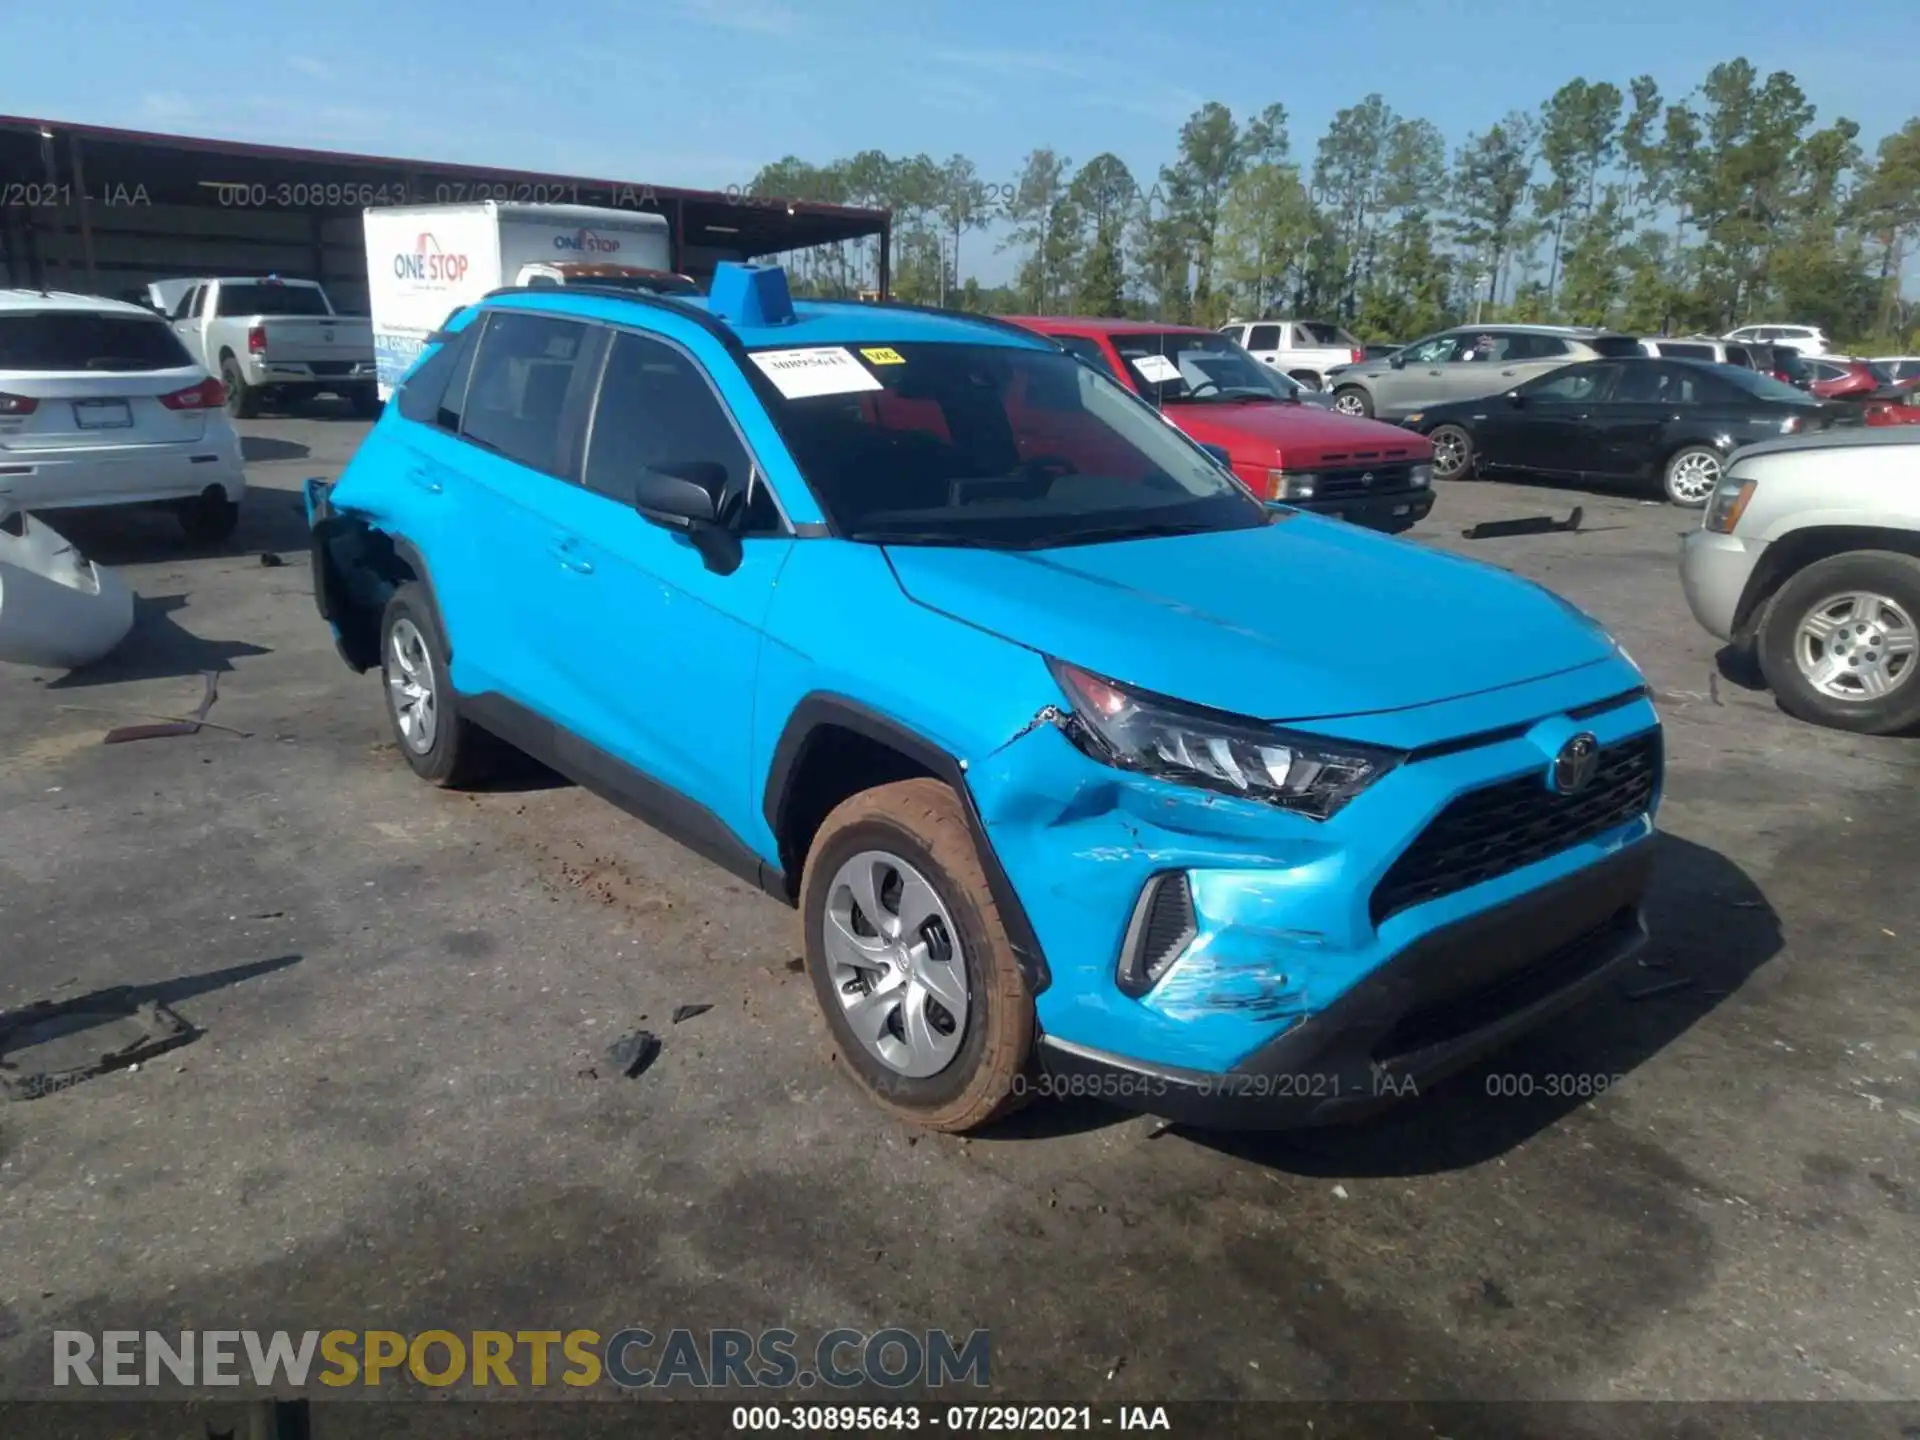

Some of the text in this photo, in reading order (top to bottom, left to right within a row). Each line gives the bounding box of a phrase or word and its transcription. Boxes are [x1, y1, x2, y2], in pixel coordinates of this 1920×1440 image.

[554, 235, 620, 252] ONE STOP
[394, 254, 468, 281] ONE STOP
